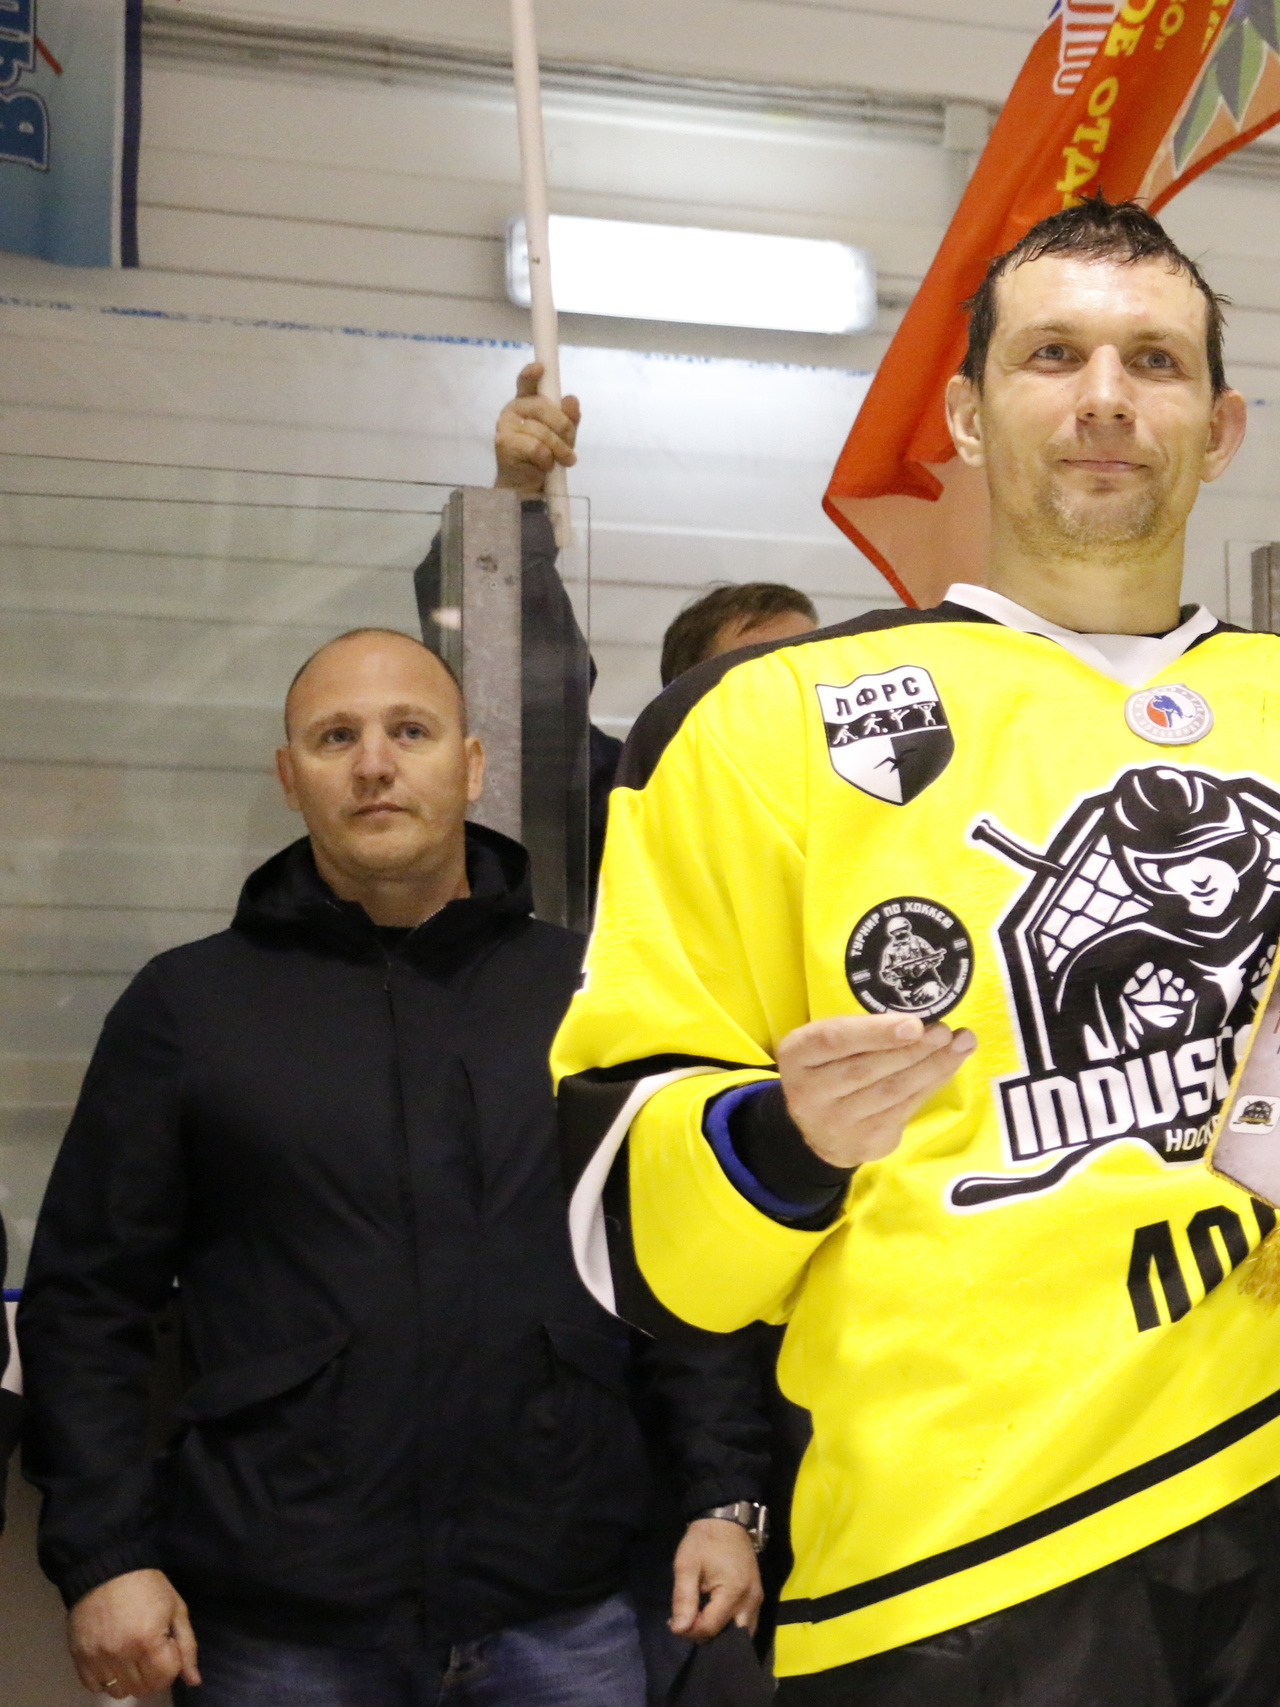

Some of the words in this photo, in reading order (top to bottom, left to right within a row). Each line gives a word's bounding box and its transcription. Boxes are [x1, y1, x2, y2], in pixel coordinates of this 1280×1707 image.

[835, 677, 920, 716] ЛФРС
[851, 913, 880, 957] ТУРНИР
[883, 903, 901, 917] ПО
[905, 902, 954, 929] ХОККЕЮ
